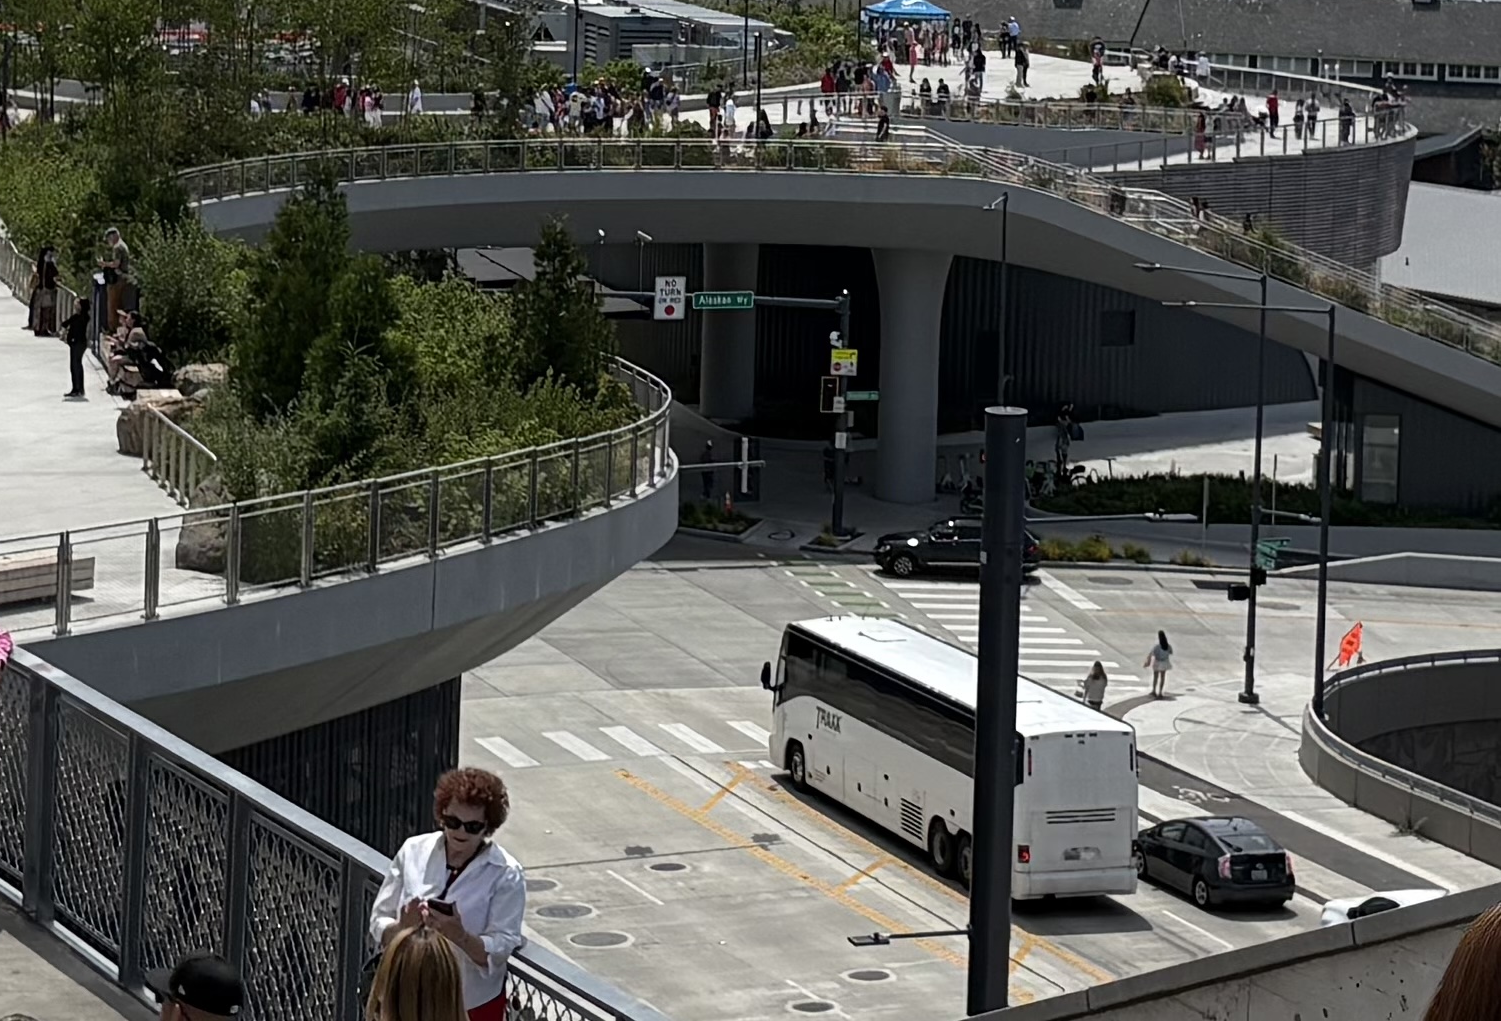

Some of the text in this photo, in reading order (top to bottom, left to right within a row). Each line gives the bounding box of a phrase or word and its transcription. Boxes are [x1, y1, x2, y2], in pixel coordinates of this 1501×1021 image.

[665, 279, 677, 288] NO
[659, 288, 681, 296] TURN
[698, 296, 732, 305] Alaskan
